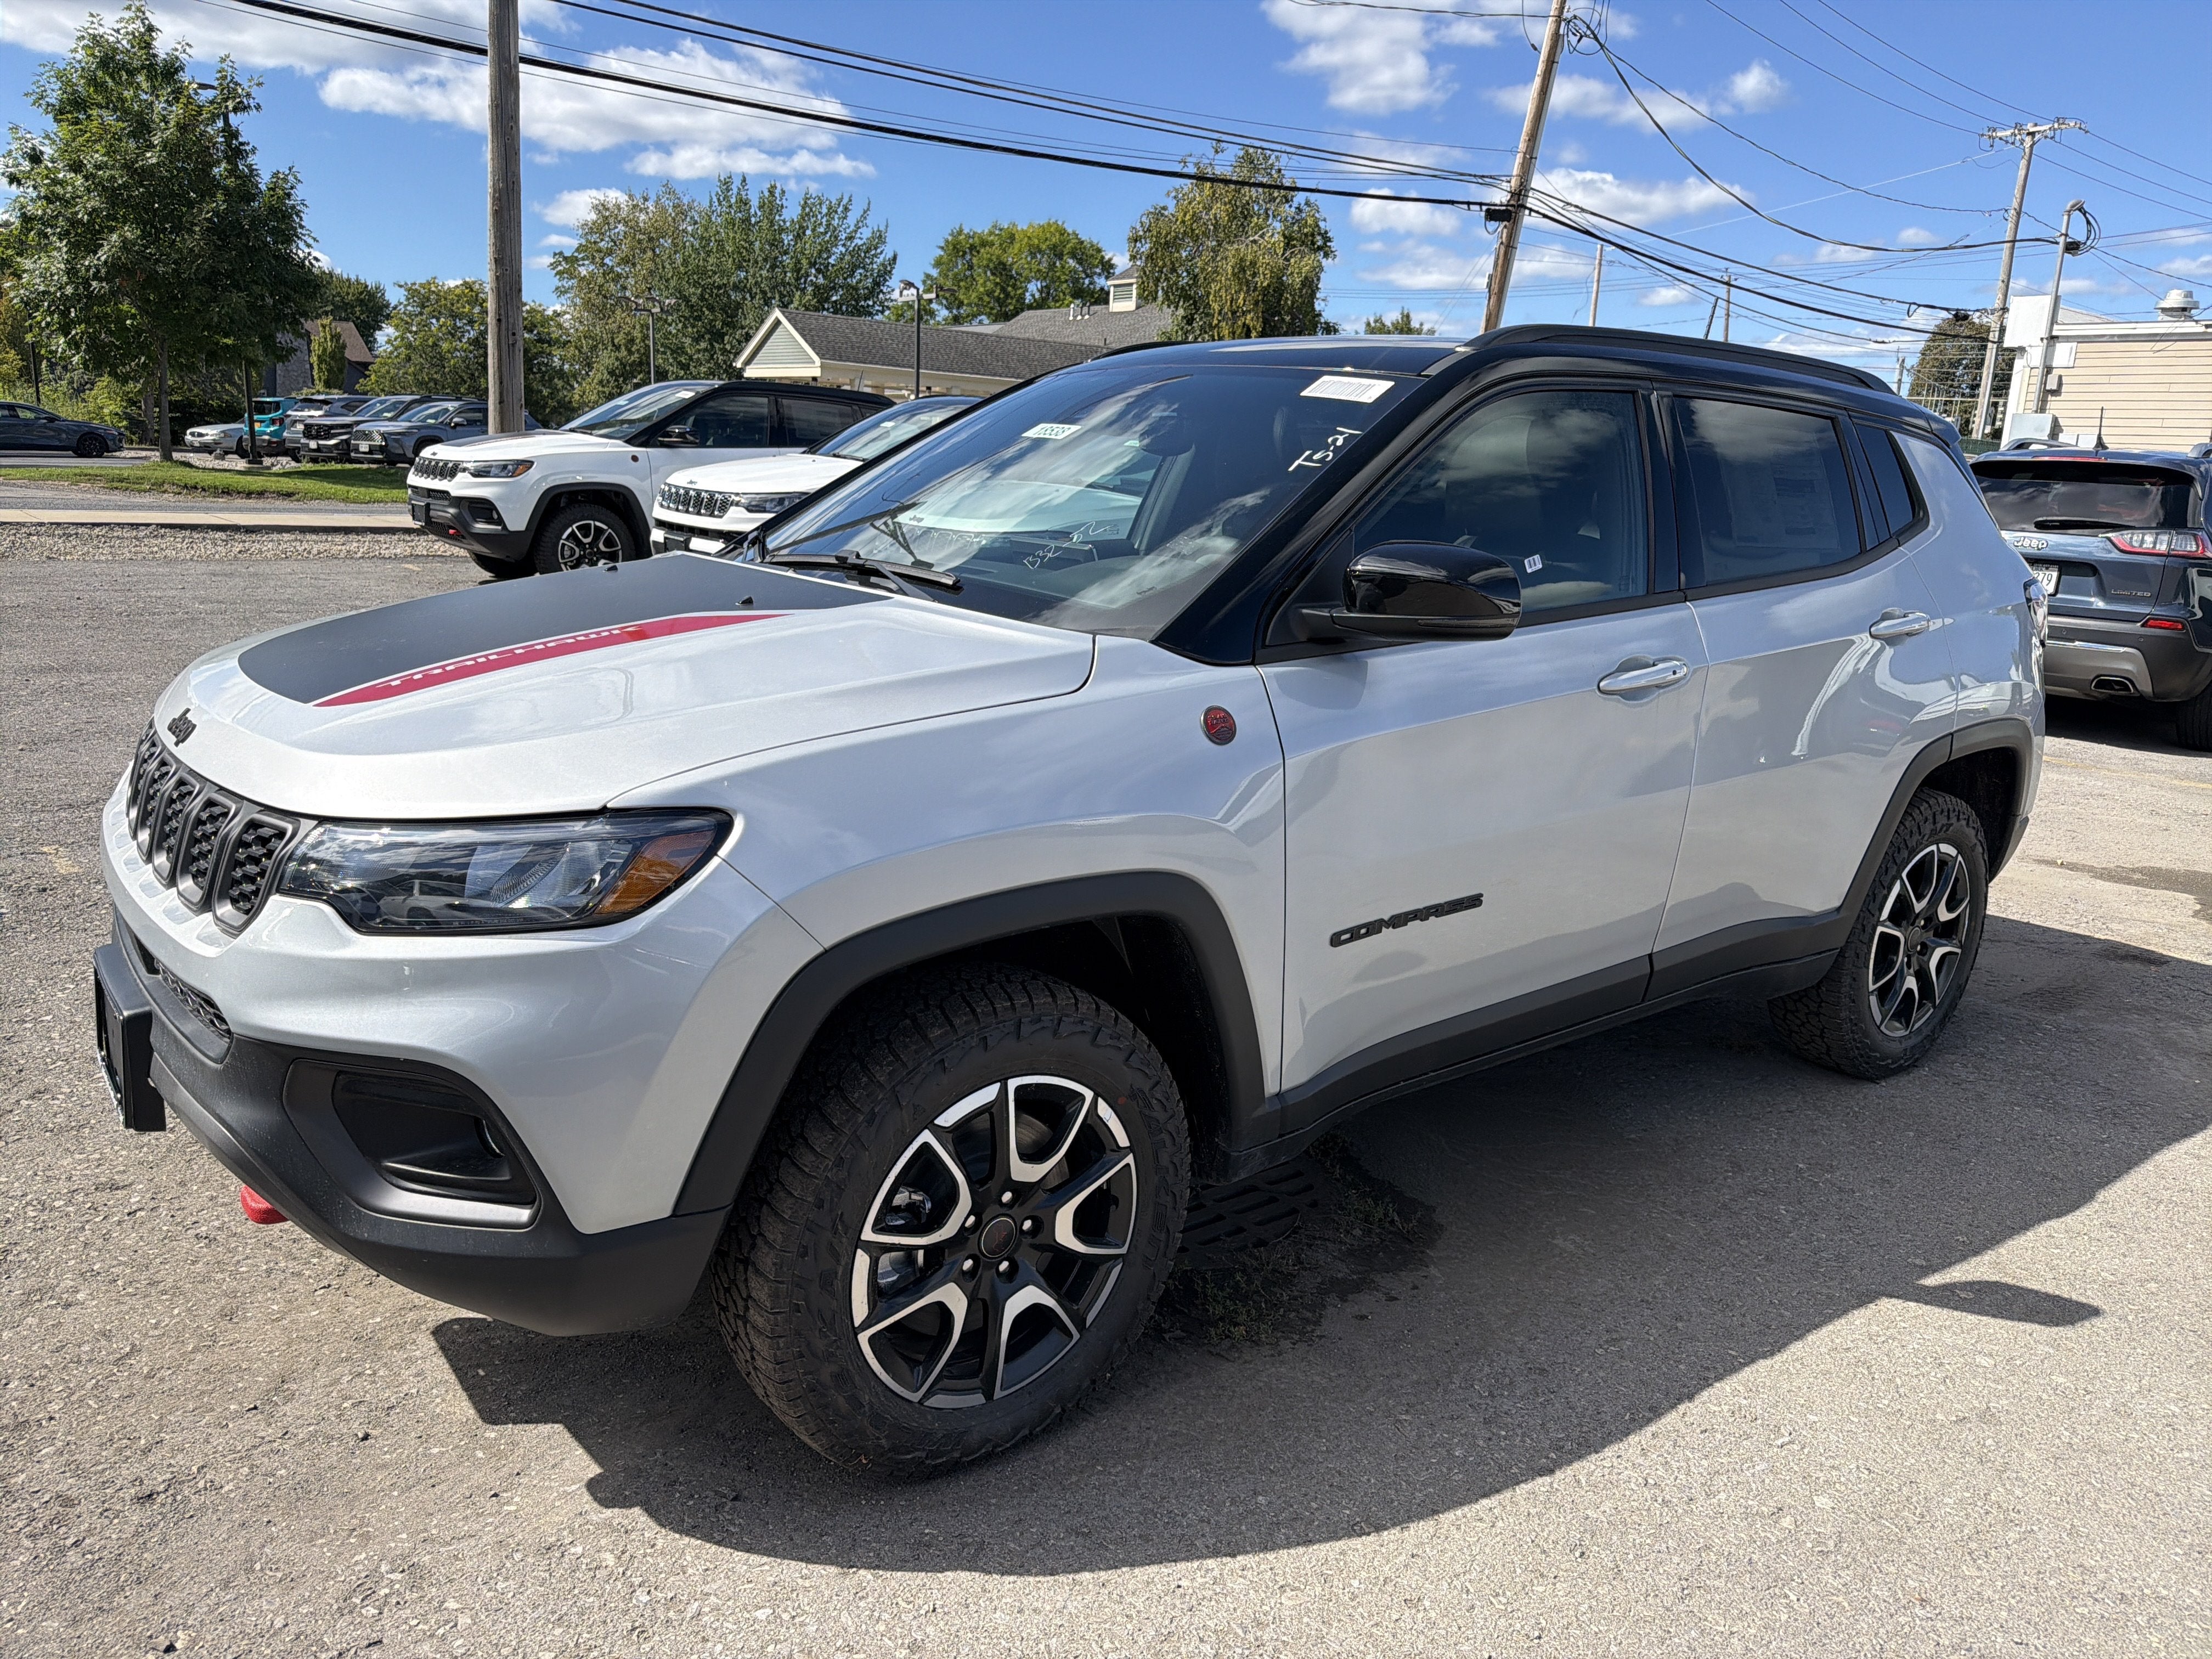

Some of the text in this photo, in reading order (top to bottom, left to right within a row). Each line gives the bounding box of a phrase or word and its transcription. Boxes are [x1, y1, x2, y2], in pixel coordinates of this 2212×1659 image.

[2013, 537, 2049, 550] Jeep
[2111, 589, 2152, 597] LIMITED
[375, 625, 643, 689] TRAILHAWK
[167, 707, 198, 748] Jeep
[1330, 893, 1484, 948] COMPASS
